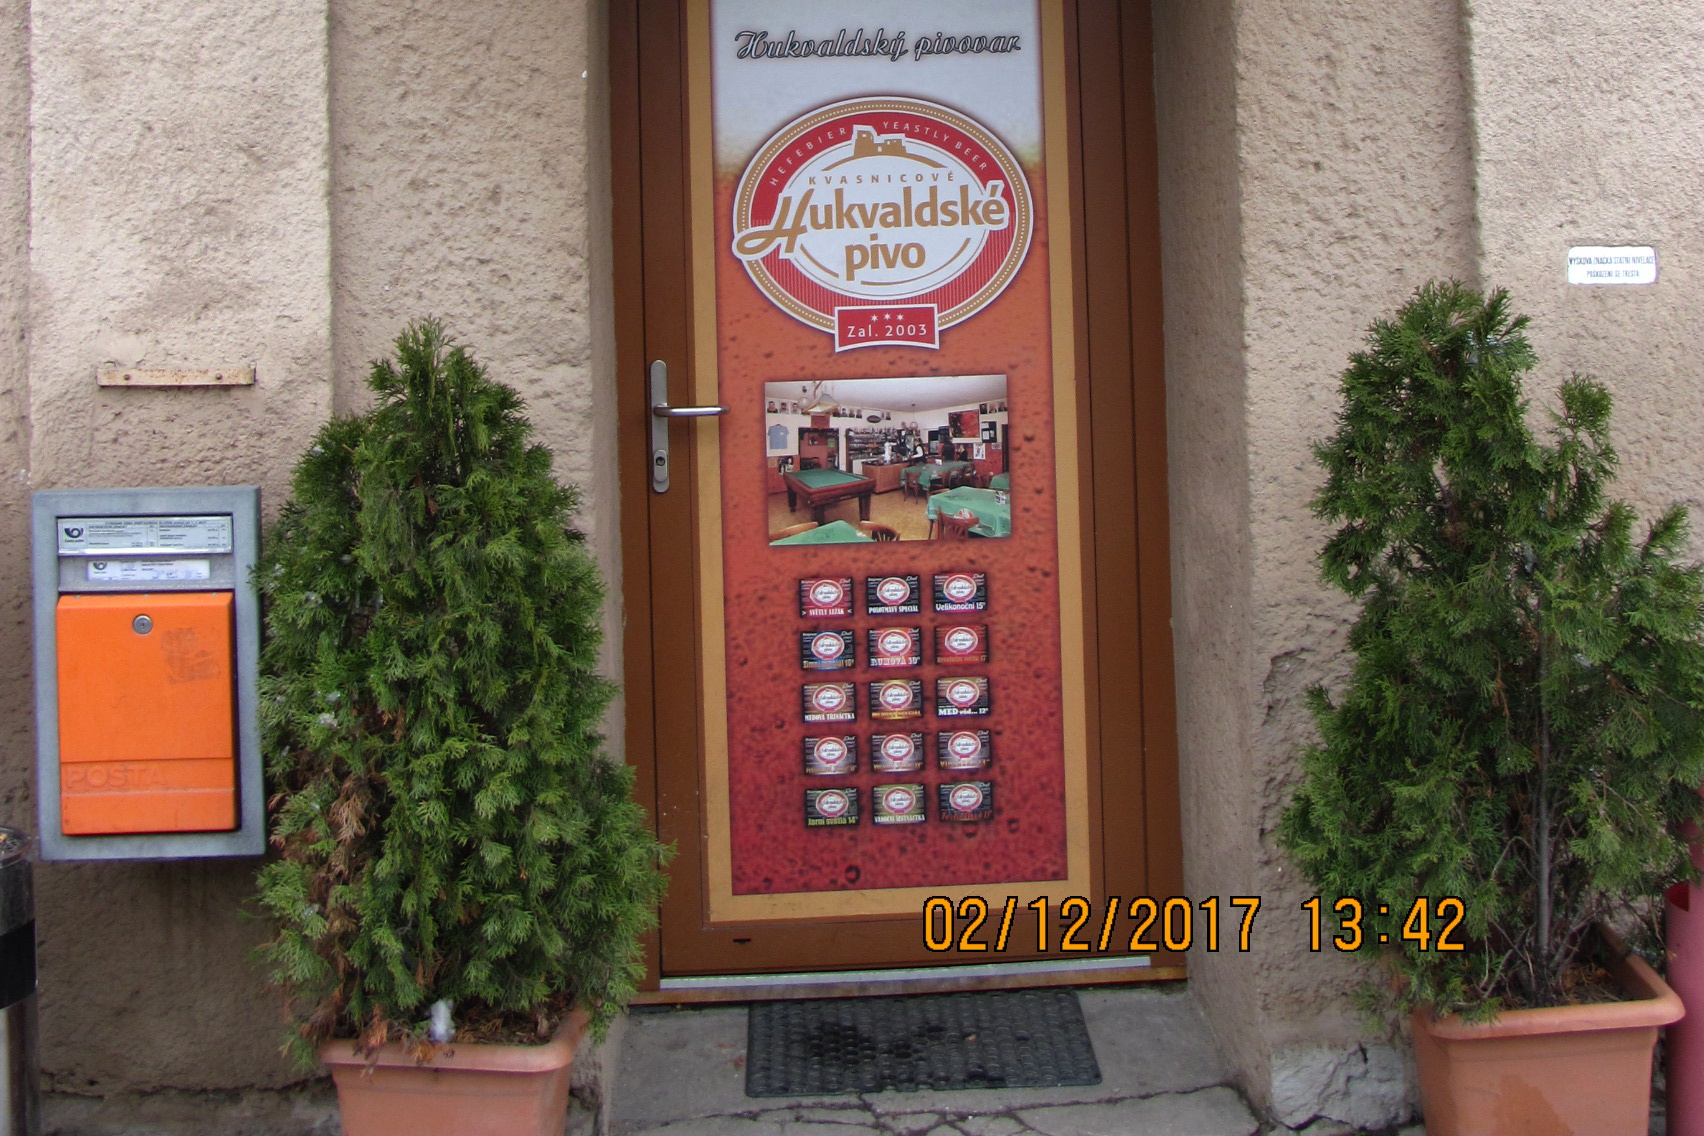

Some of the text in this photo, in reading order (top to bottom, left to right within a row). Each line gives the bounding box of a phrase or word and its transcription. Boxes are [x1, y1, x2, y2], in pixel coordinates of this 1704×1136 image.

[734, 27, 1021, 62] Hukvaldský pivovar
[769, 127, 847, 187] HEFEBIER
[882, 121, 987, 171] YEASTLY BEER
[808, 171, 955, 185] KVASNICOVÉ
[736, 183, 1006, 255] Hukvaldské
[844, 232, 926, 282] pivo
[847, 324, 928, 338] Zal. 2003
